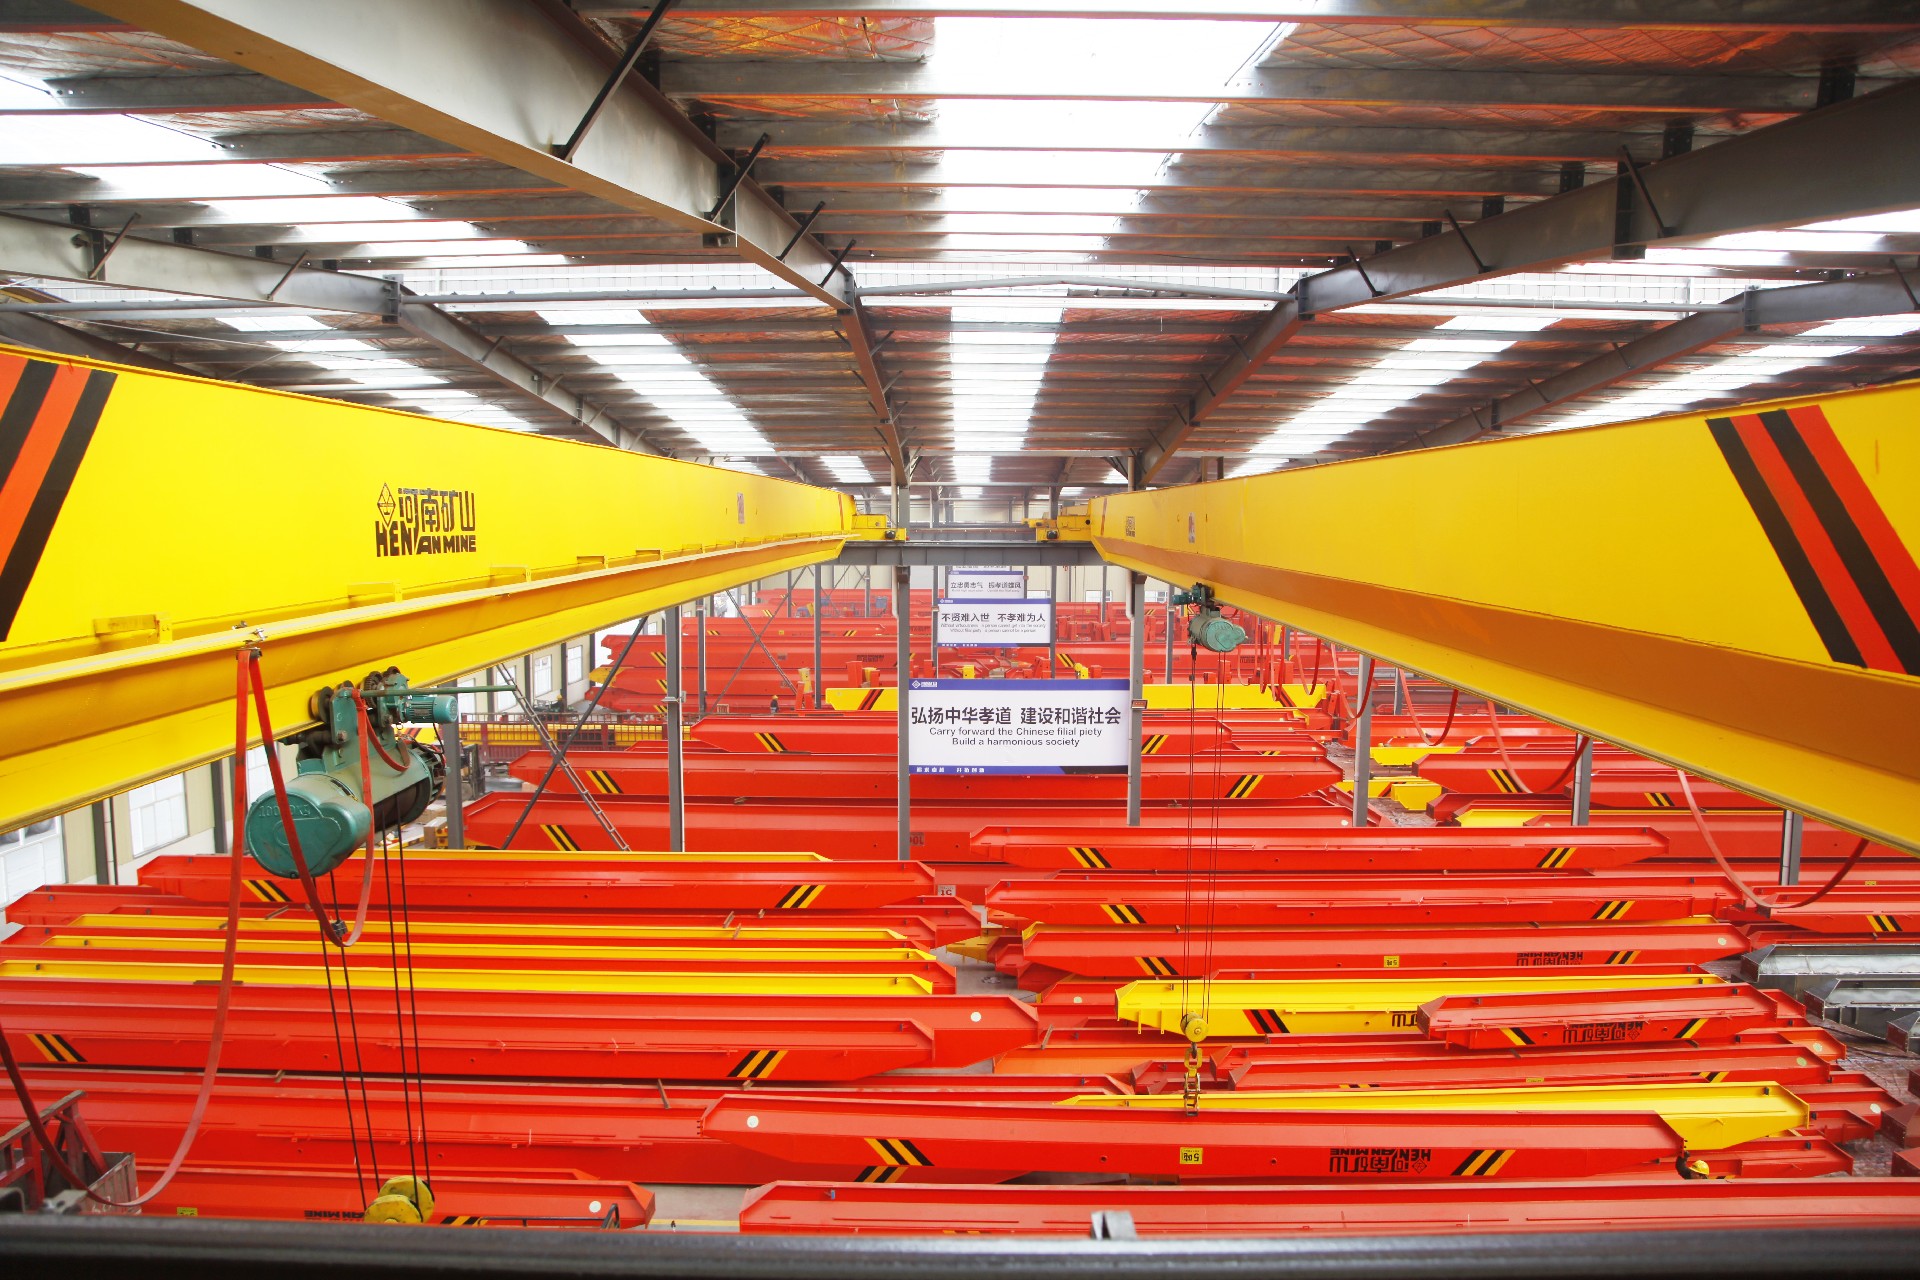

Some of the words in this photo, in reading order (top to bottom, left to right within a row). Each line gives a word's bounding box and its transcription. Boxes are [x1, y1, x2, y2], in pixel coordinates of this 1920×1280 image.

[375, 521, 441, 557] HENAN
[443, 535, 476, 553] MINE
[941, 613, 990, 622] 不贤难入世
[997, 613, 1045, 622] 不孝难为人
[911, 706, 1012, 725] 弘扬中华孝道
[1020, 706, 1122, 725] 建设和谐社会
[929, 727, 955, 736] Carry
[958, 727, 995, 736] forward
[997, 727, 1013, 736] the
[1016, 727, 1054, 736] Chinese
[1057, 727, 1077, 736] filial
[1079, 727, 1102, 737] piety
[952, 737, 976, 746] Build
[987, 737, 1043, 746] harmonious
[1045, 737, 1080, 747] society
[1330, 1148, 1369, 1156] MINE
[1371, 1148, 1432, 1161] HENAN
[1329, 1156, 1409, 1173] 河南矿山
